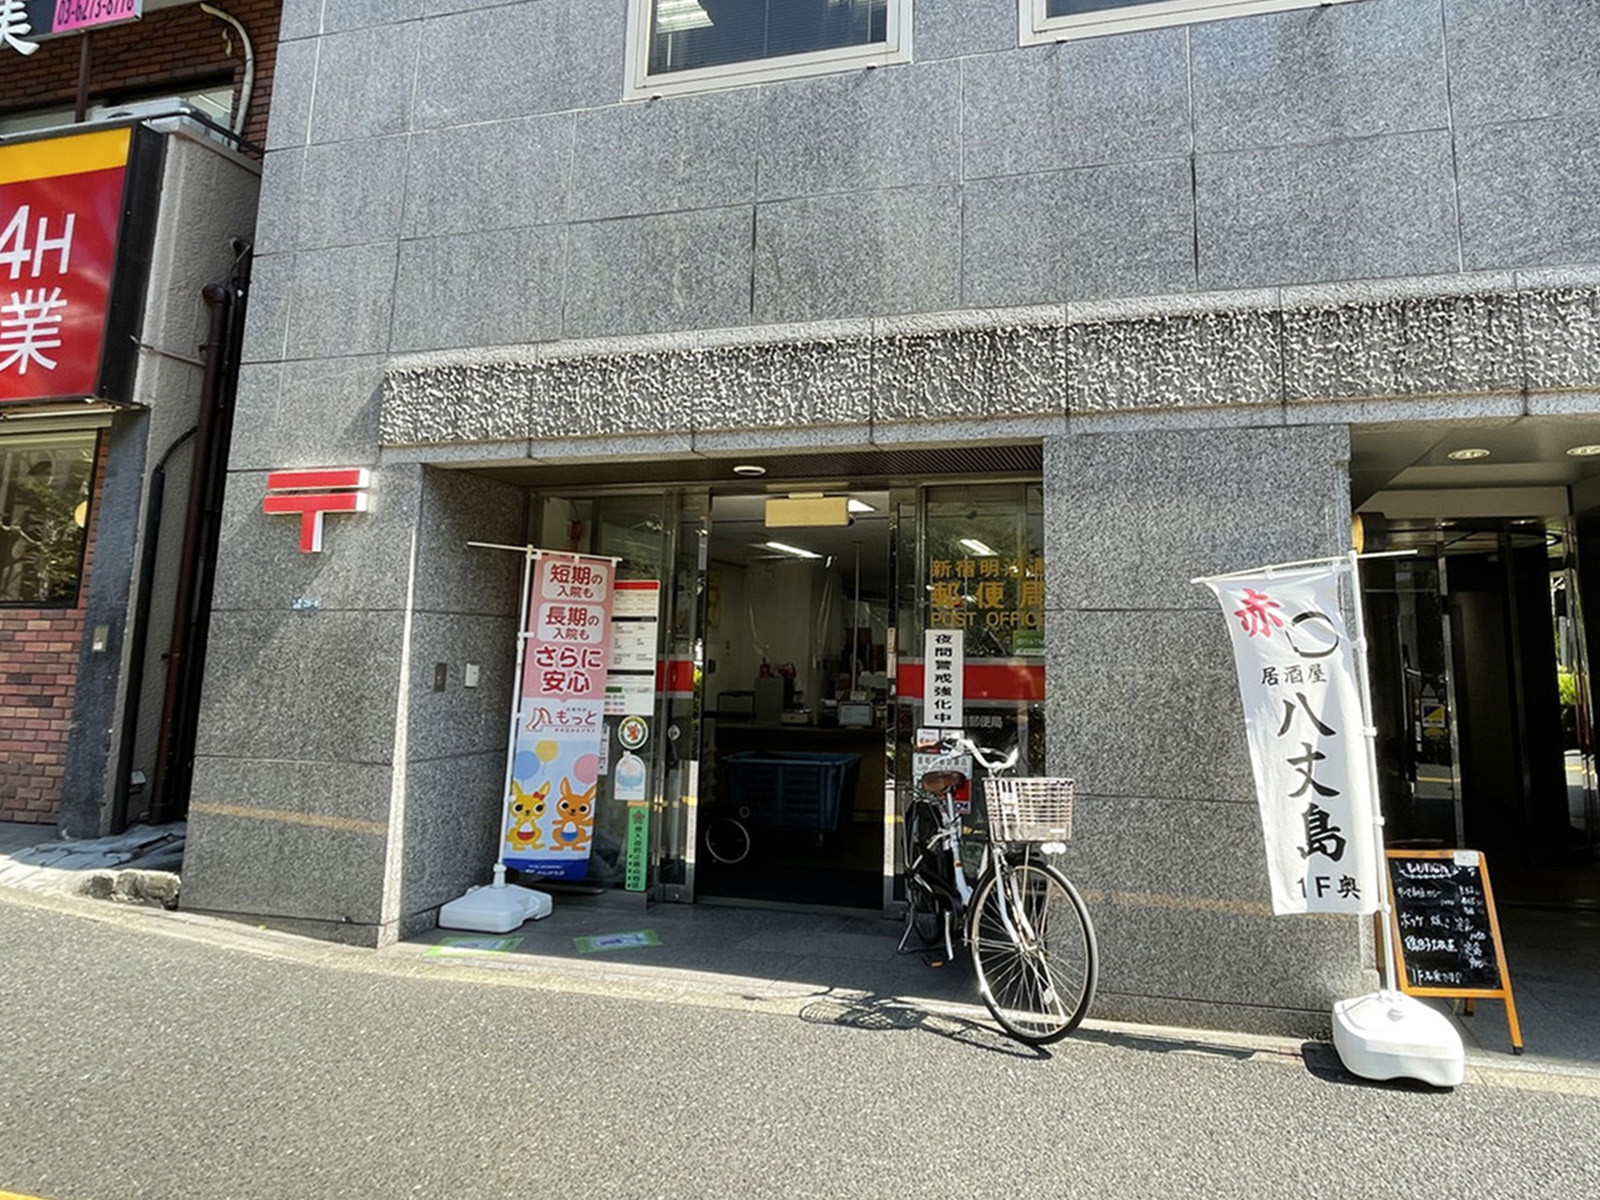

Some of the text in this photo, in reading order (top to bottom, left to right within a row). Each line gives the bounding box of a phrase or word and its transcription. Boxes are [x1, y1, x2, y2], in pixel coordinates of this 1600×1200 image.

[0, 287, 67, 375] 業
[549, 564, 603, 585] 短期の
[557, 585, 594, 599] 入院も
[931, 581, 1044, 609] 郵便局
[545, 606, 600, 627] 長期の
[931, 612, 976, 627] POST
[552, 627, 590, 640] 入院も
[536, 645, 602, 669] さらに
[541, 671, 591, 693] 安心
[934, 633, 953, 724] 夜間警戒強化中
[1260, 665, 1328, 686] 居酒屋
[556, 709, 597, 726] もっと
[1277, 692, 1347, 862] 八丈島
